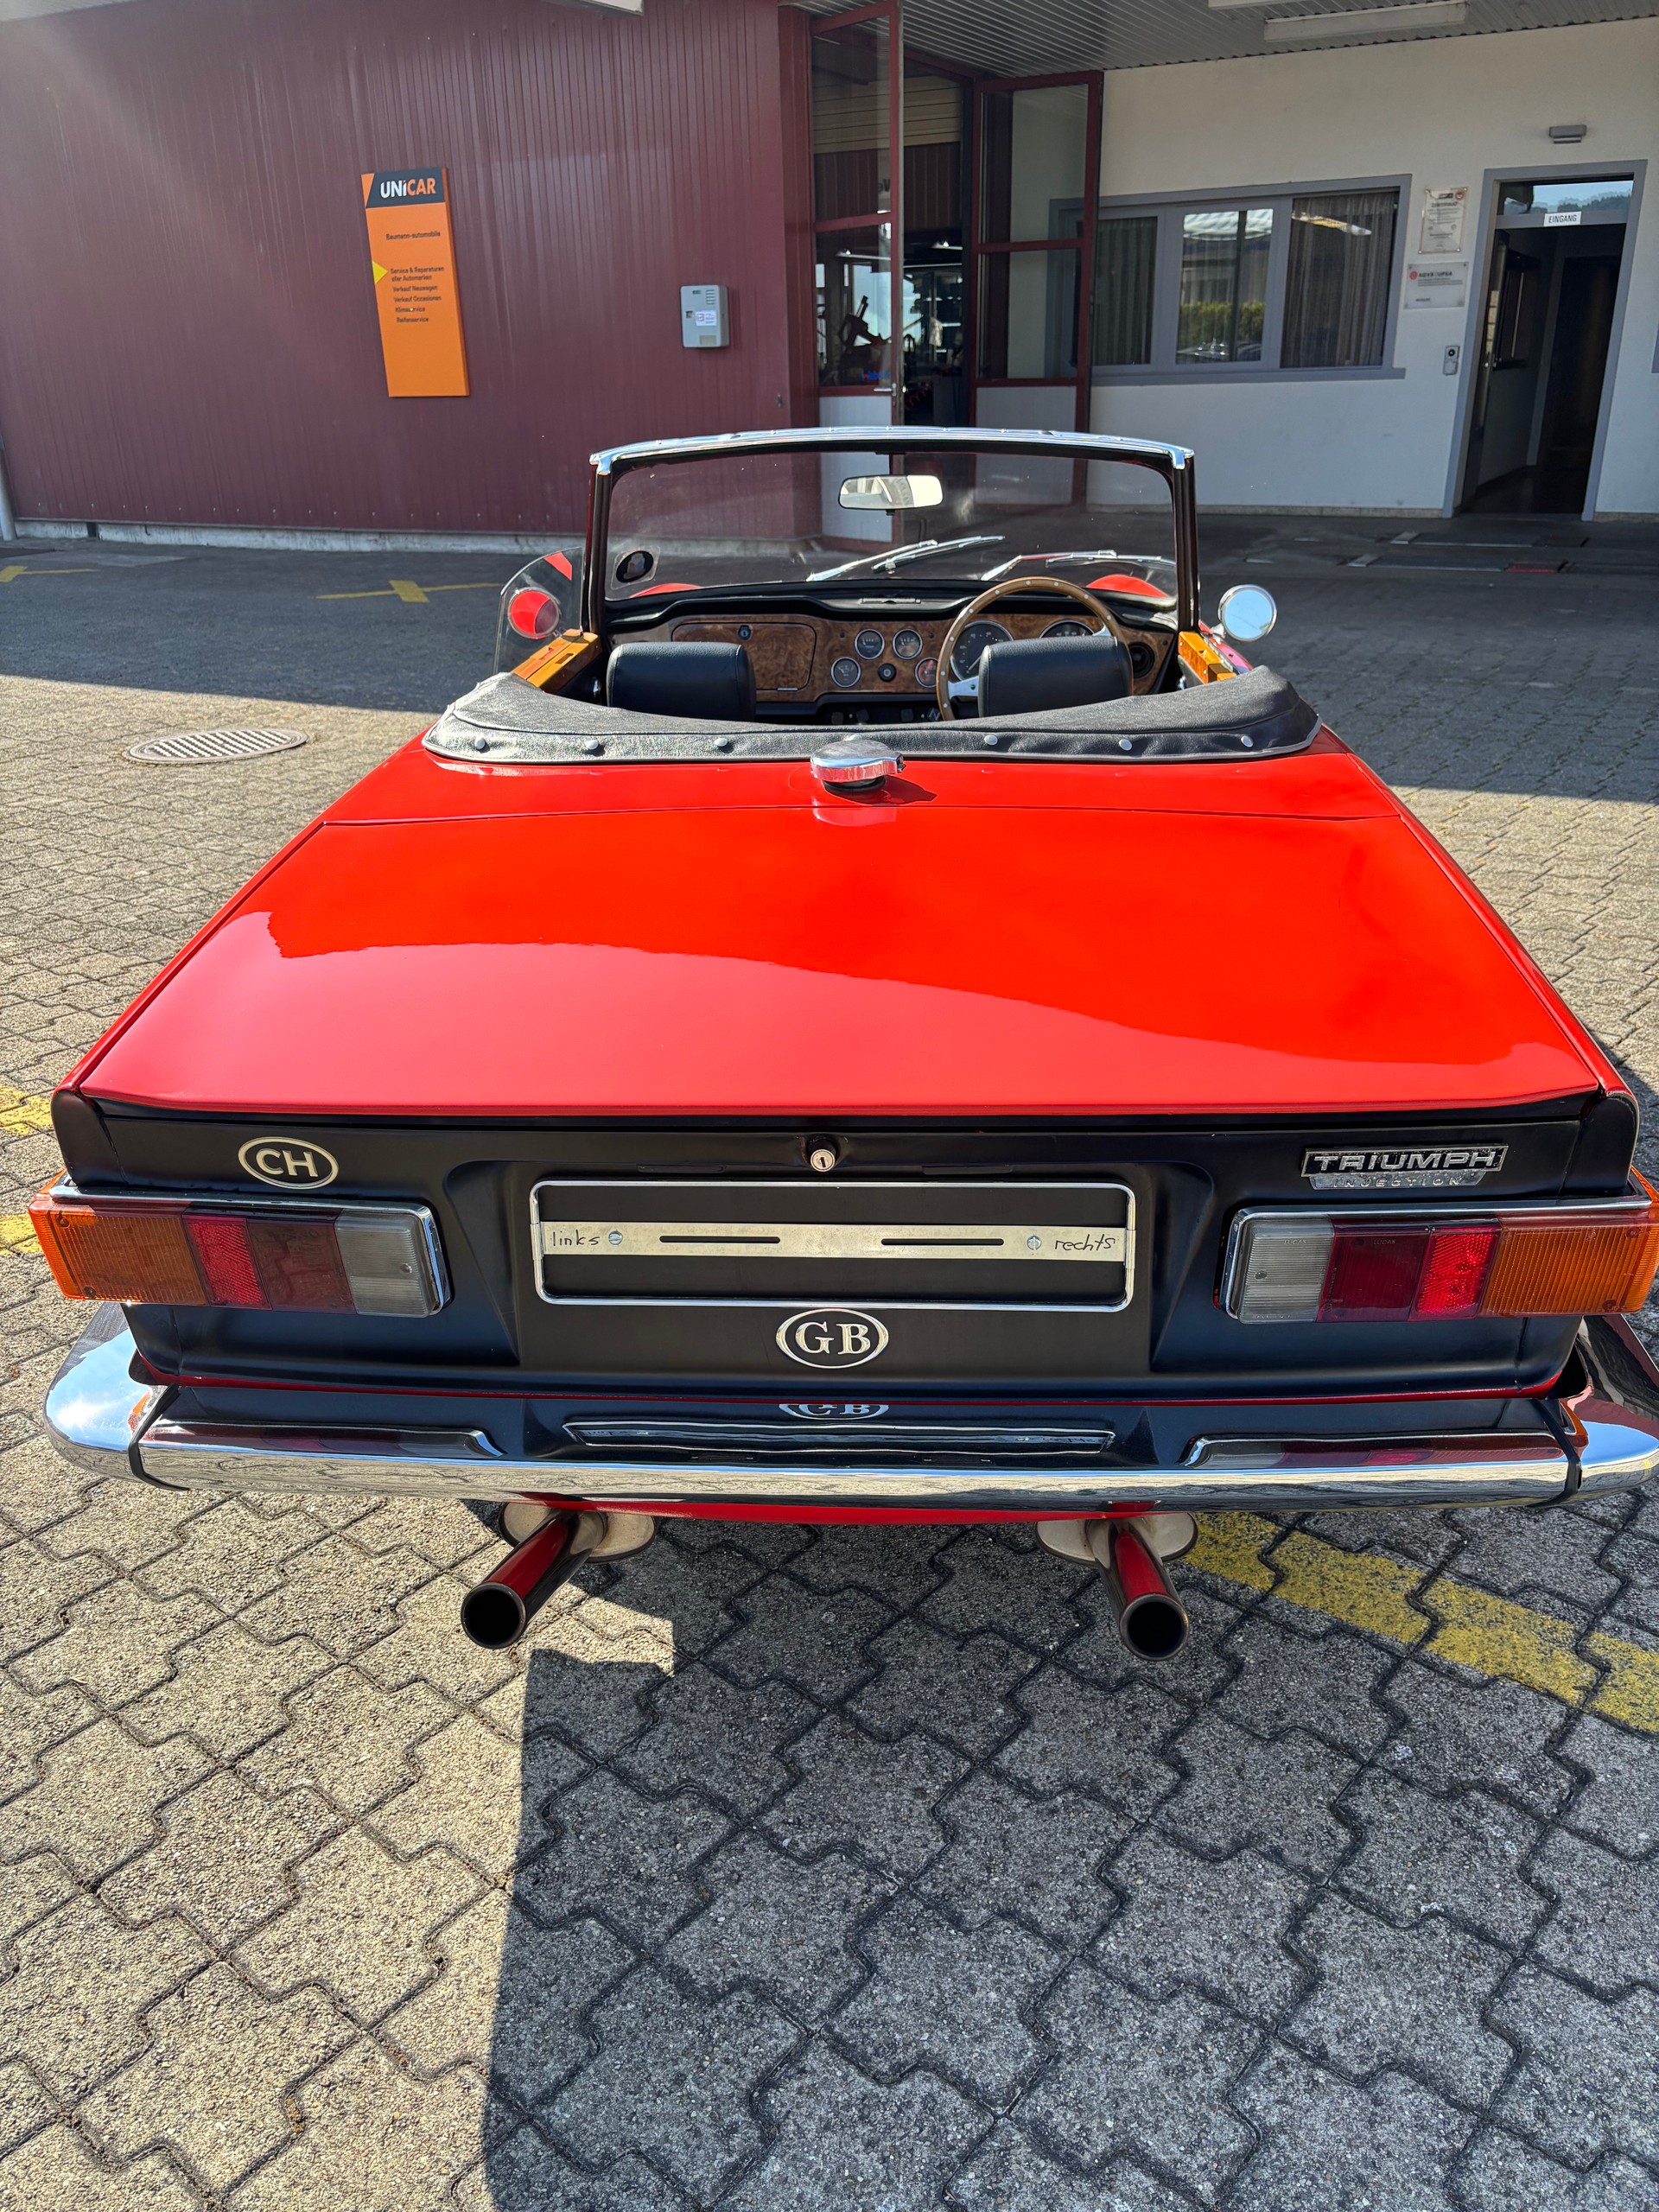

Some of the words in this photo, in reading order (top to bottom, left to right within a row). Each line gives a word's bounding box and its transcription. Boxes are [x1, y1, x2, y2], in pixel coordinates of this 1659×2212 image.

[1548, 213, 1577, 224] EINGANG
[256, 1148, 319, 1178] CH
[1314, 1150, 1496, 1173] TRIUMPH
[1332, 1175, 1462, 1189] INJECTION
[553, 1229, 601, 1247] links
[1054, 1233, 1116, 1251] rechts
[794, 1320, 872, 1355] GB
